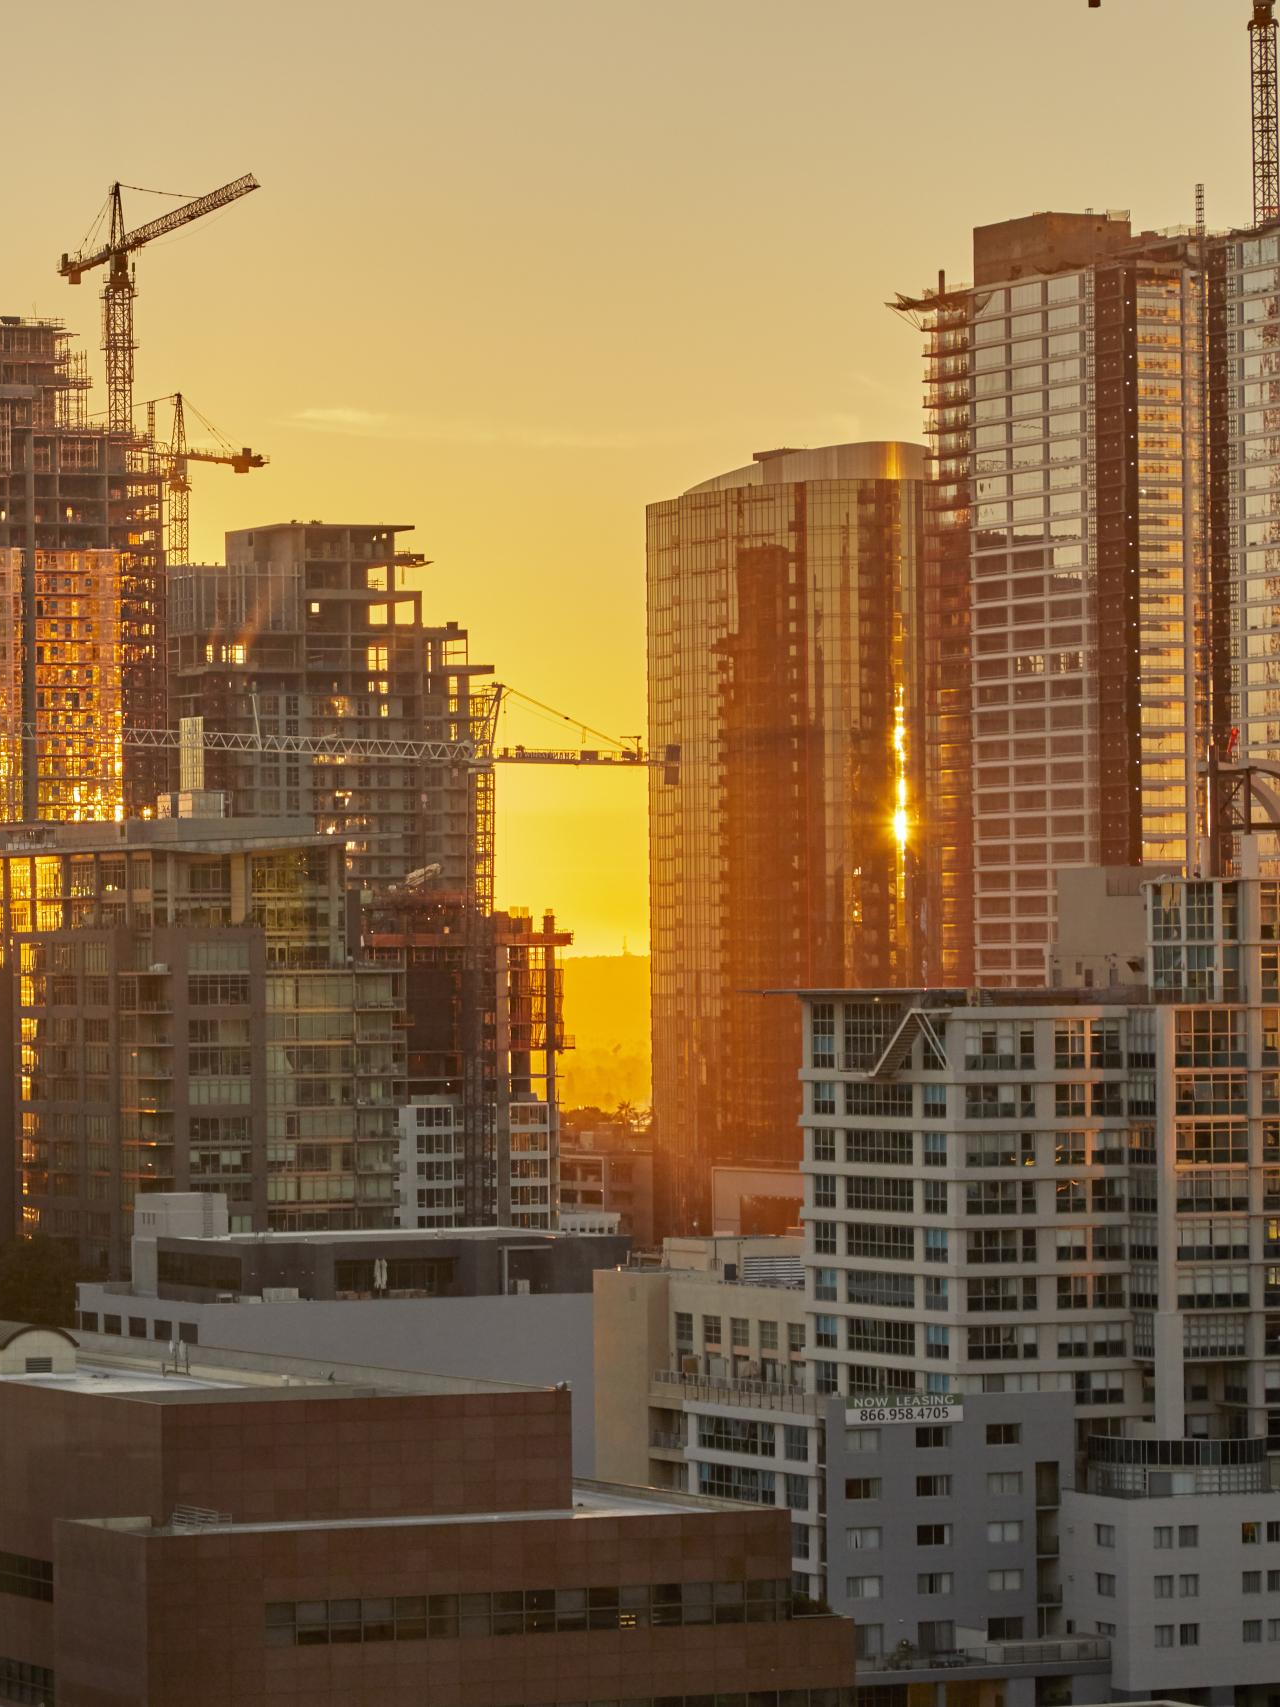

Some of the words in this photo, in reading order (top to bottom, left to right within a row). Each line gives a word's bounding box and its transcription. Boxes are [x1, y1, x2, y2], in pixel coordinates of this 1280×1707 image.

[854, 1397, 888, 1408] NOW
[896, 1395, 955, 1406] LEASING
[860, 1407, 949, 1421] 866.958.4705
